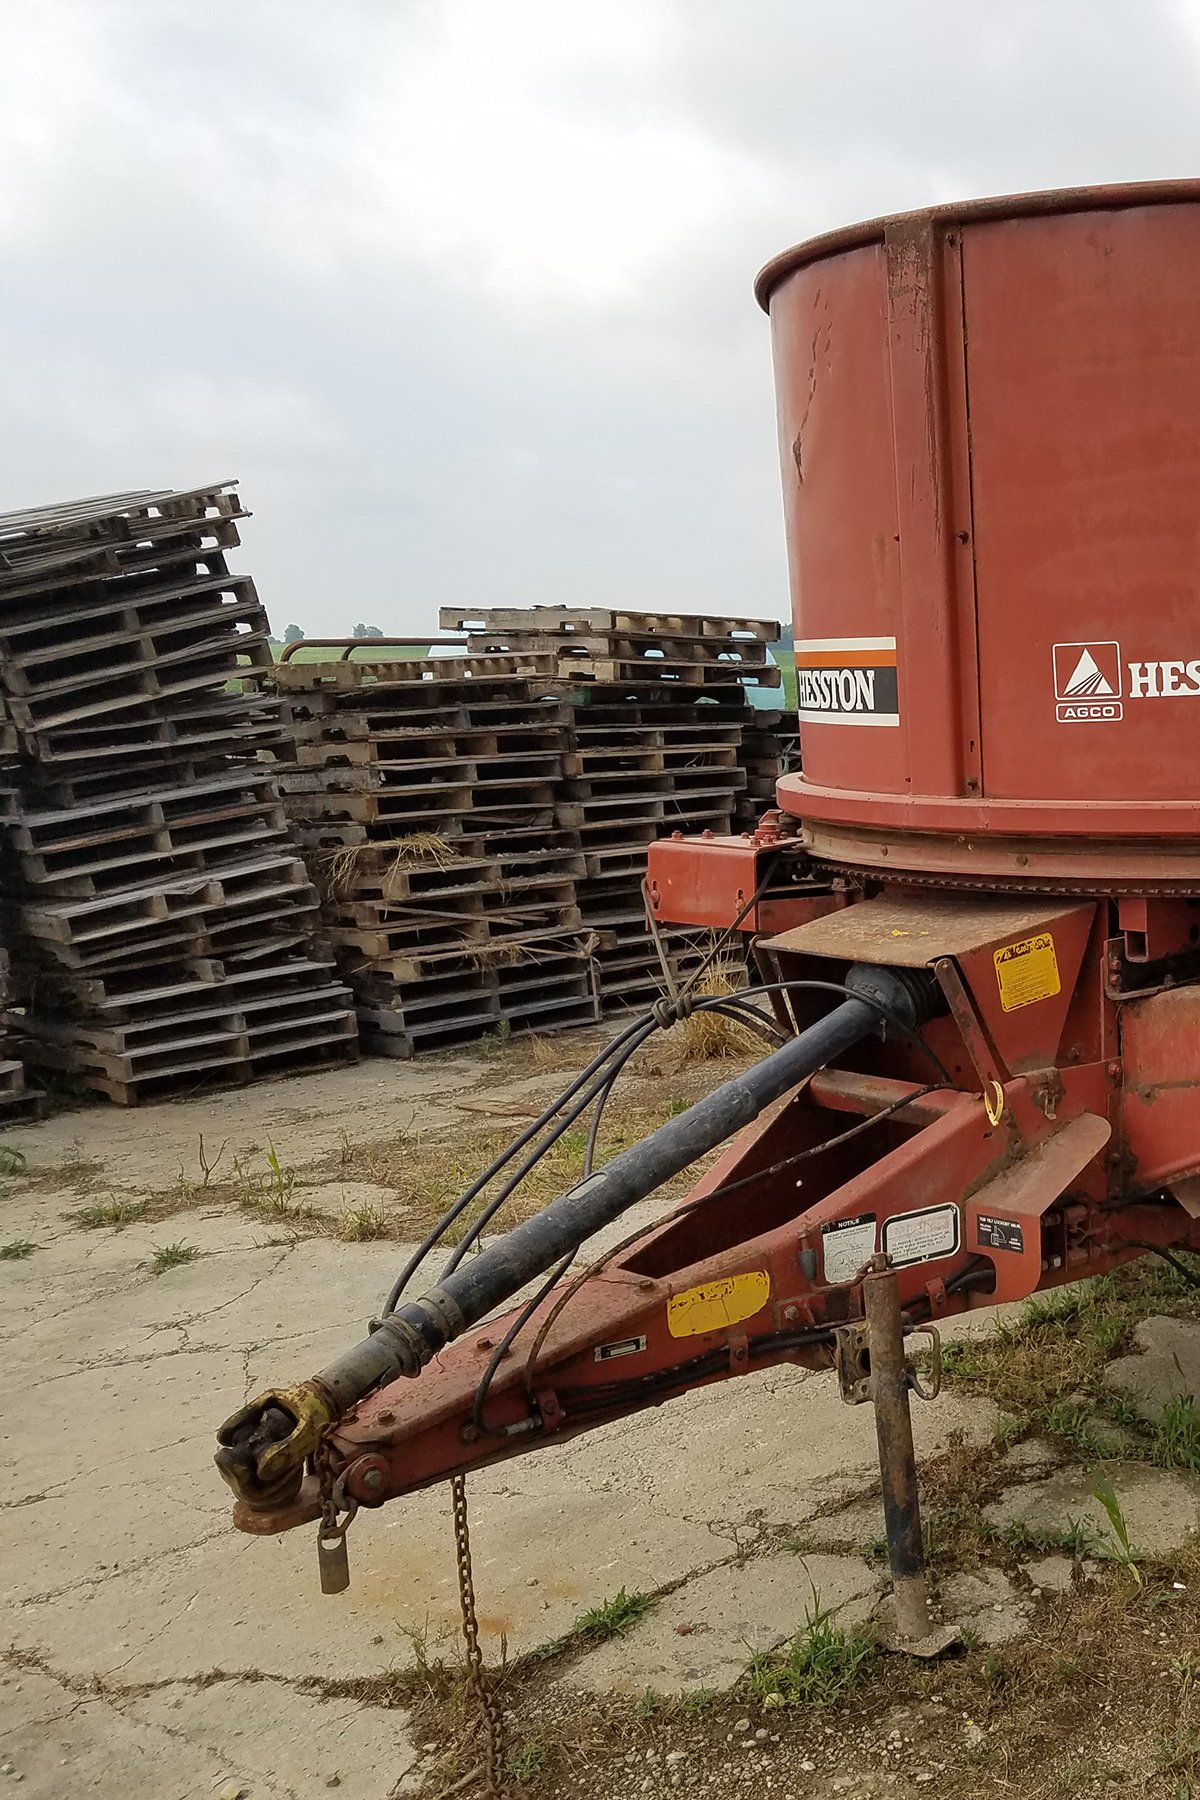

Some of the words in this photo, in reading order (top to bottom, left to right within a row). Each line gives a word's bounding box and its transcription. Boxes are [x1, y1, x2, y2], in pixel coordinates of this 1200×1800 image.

[798, 668, 875, 711] HESSTON
[1064, 706, 1115, 718] AGCO
[838, 1218, 860, 1228] NOTICE
